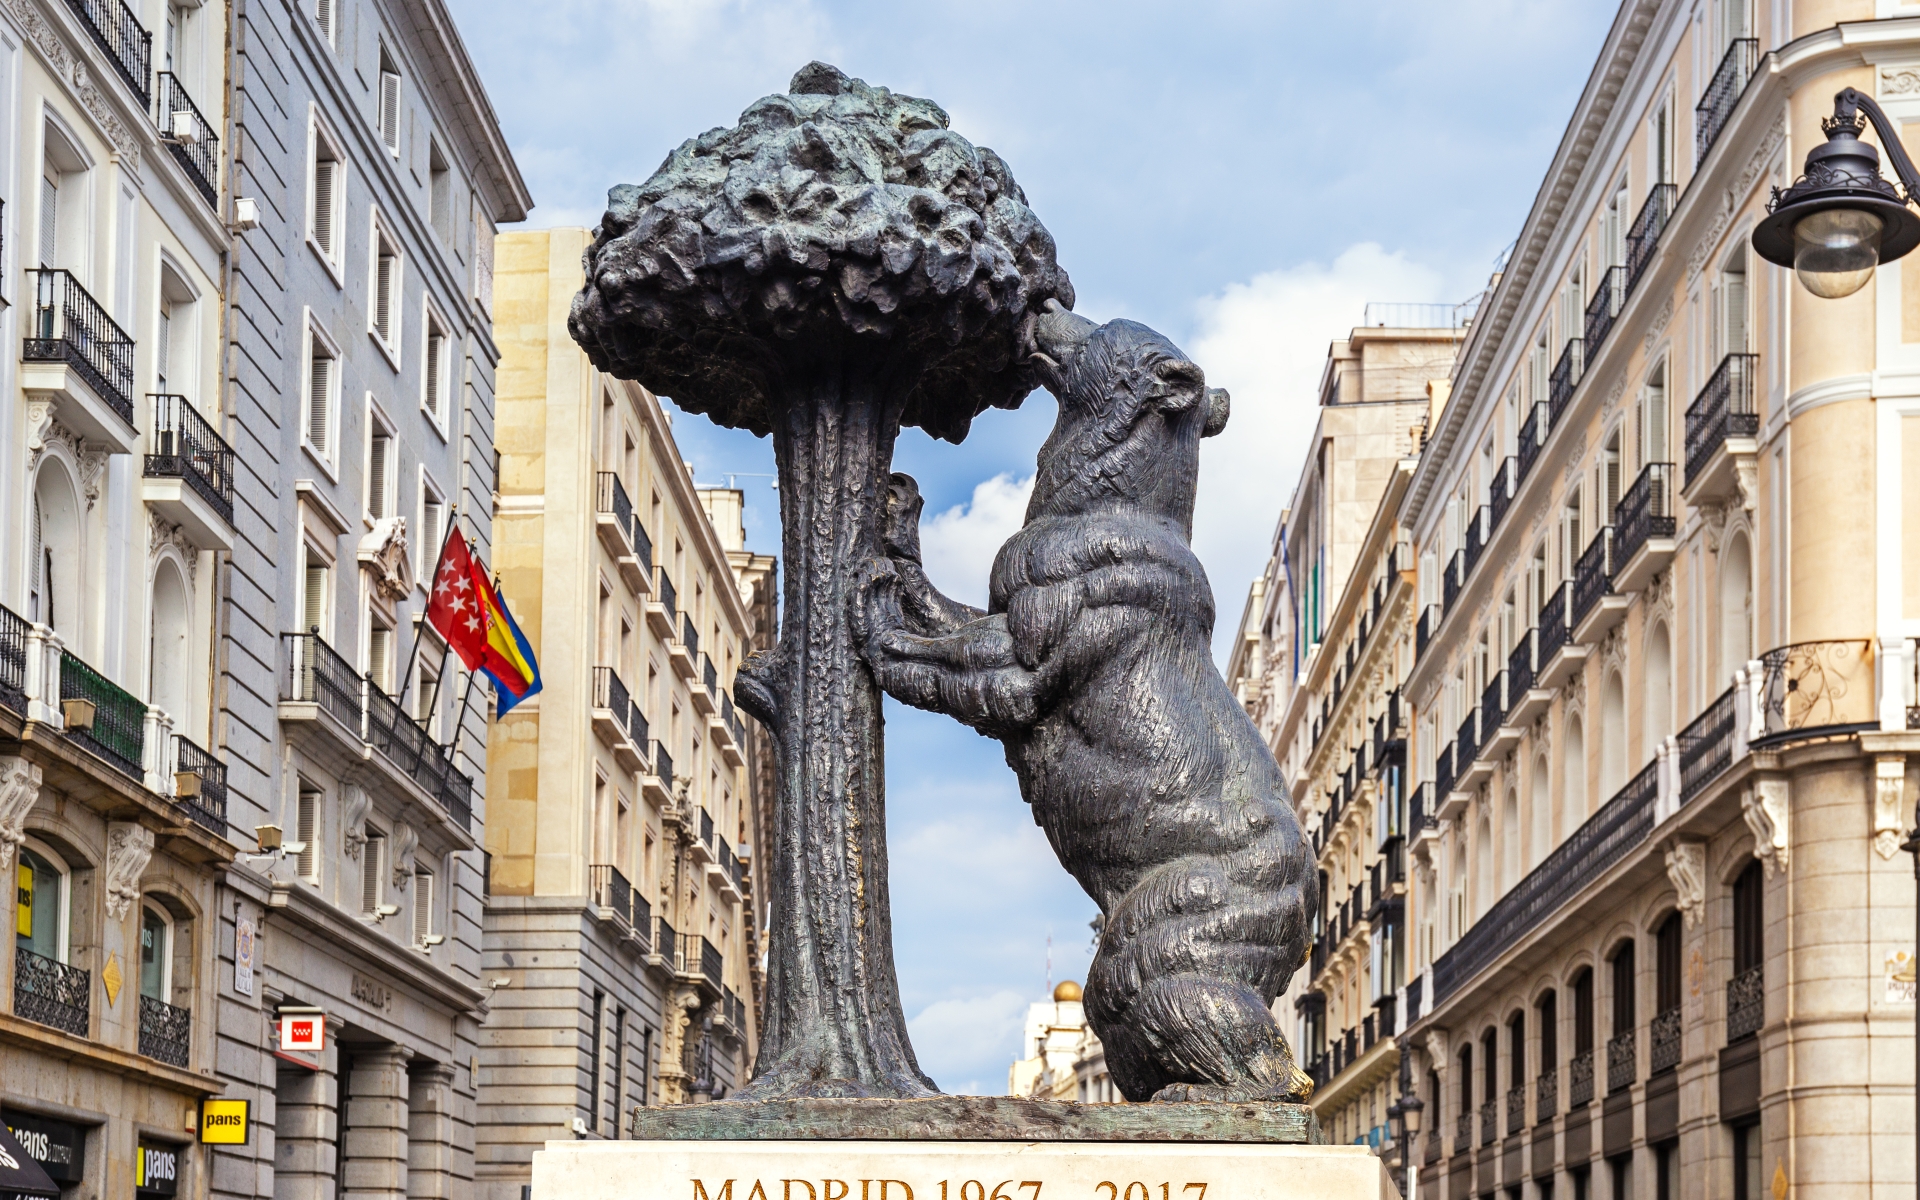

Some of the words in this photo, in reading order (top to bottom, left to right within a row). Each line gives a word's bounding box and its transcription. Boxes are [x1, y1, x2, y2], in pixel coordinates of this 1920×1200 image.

[206, 1114, 241, 1129] pans
[145, 1149, 175, 1187] pans
[690, 1178, 915, 1200] MADRID
[936, 1179, 1043, 1200] 1967
[1095, 1180, 1208, 1200] 2017
